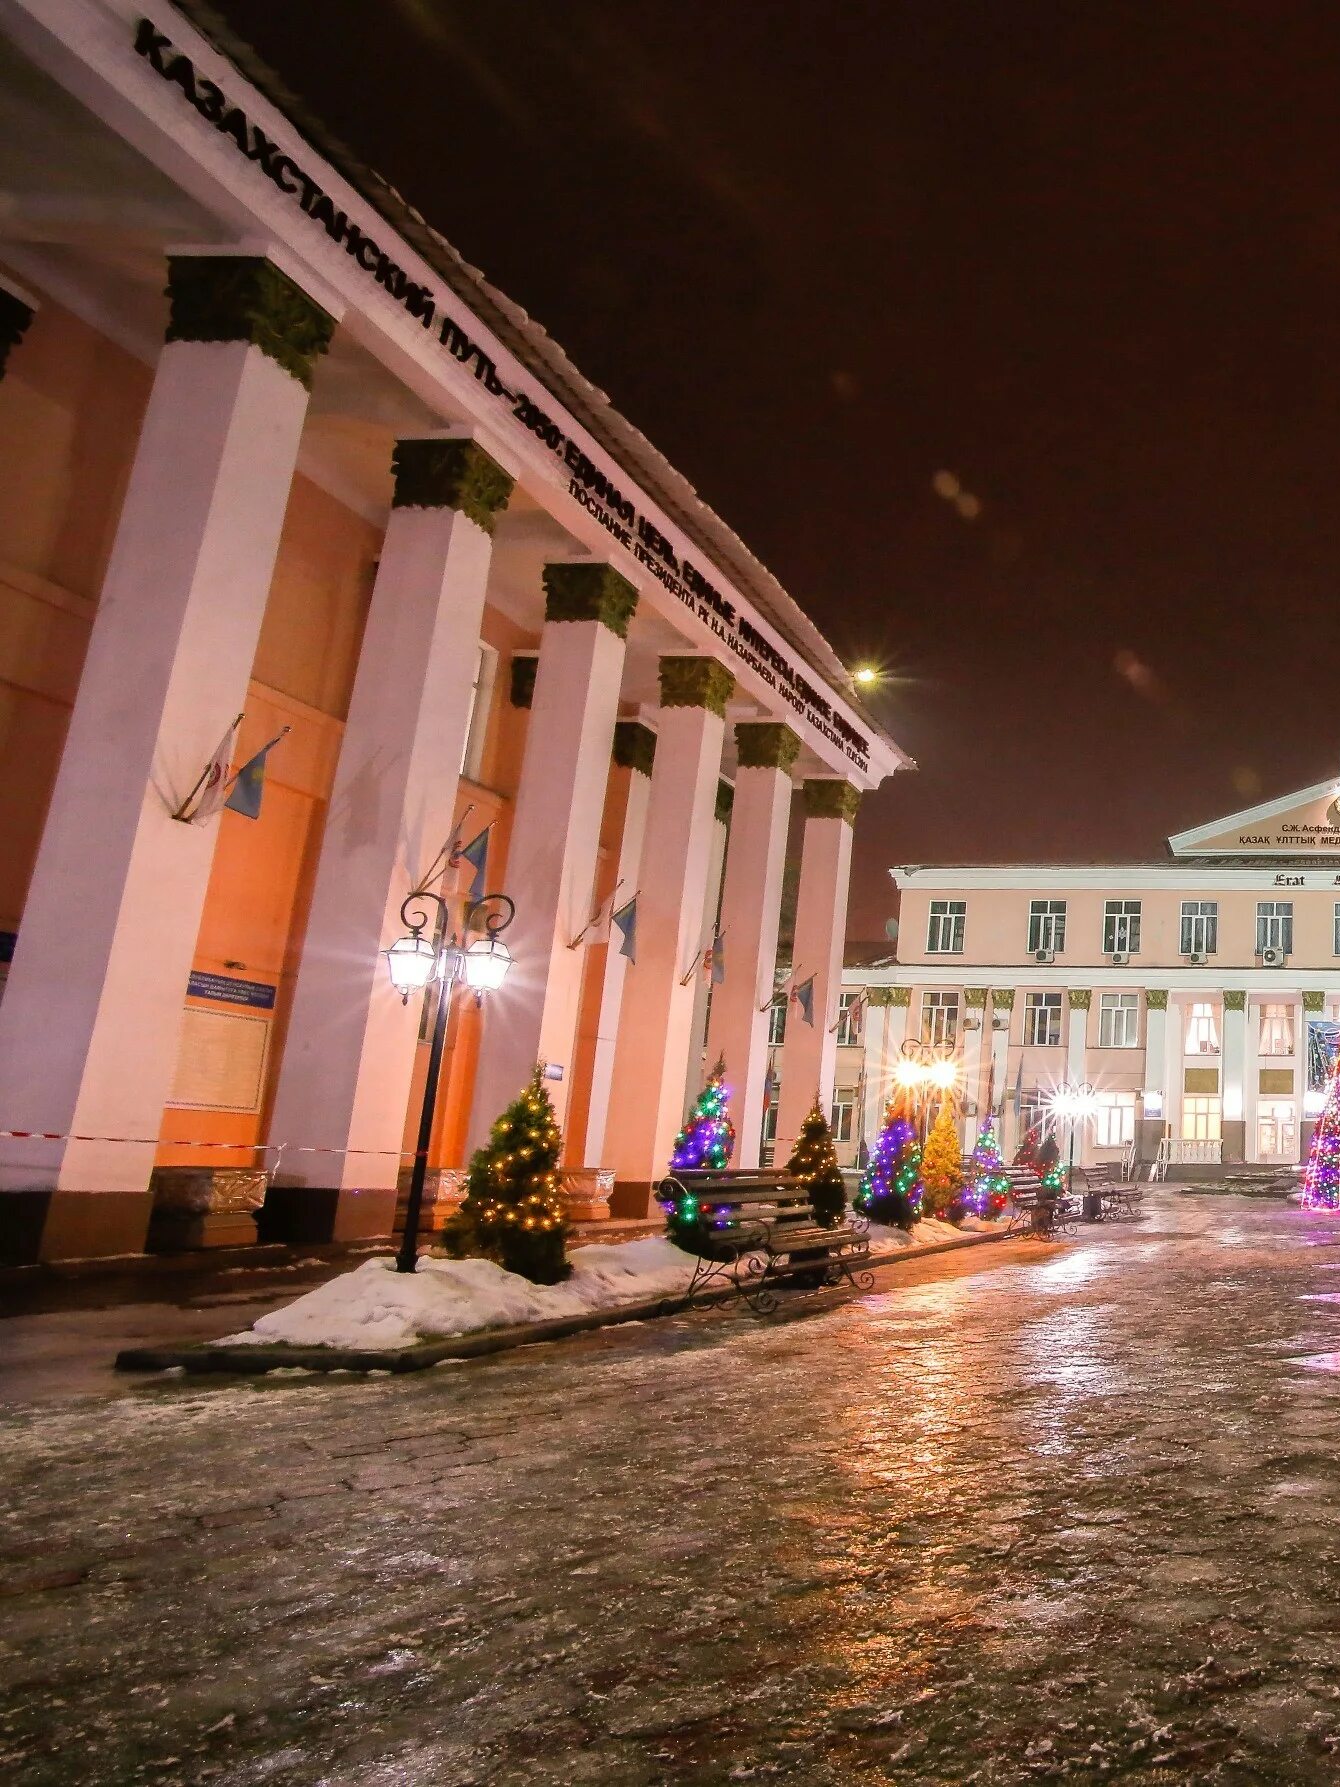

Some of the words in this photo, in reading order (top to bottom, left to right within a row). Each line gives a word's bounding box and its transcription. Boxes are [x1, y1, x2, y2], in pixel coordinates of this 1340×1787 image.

[134, 18, 435, 328] КАЗАХСТАНСКИЙ
[565, 441, 635, 527] ЕДИНАЯ
[638, 515, 680, 577] ЦЕЛЬ,
[682, 560, 737, 627] ЕДИНЫЕ
[568, 478, 632, 551] ПОСЛАНИЕ
[633, 542, 696, 613] ПРЕЗИДЕНТА
[698, 605, 710, 625] РК
[726, 633, 776, 690] НАЗАРБАЕВА
[778, 682, 805, 715] НАРОДУ
[806, 708, 844, 752] КАЗАХСТАНА
[1239, 836, 1270, 844] ҚАЗАҚ
[1276, 836, 1316, 845] ҰЛТТЫҚ
[1273, 874, 1306, 886] Erat
